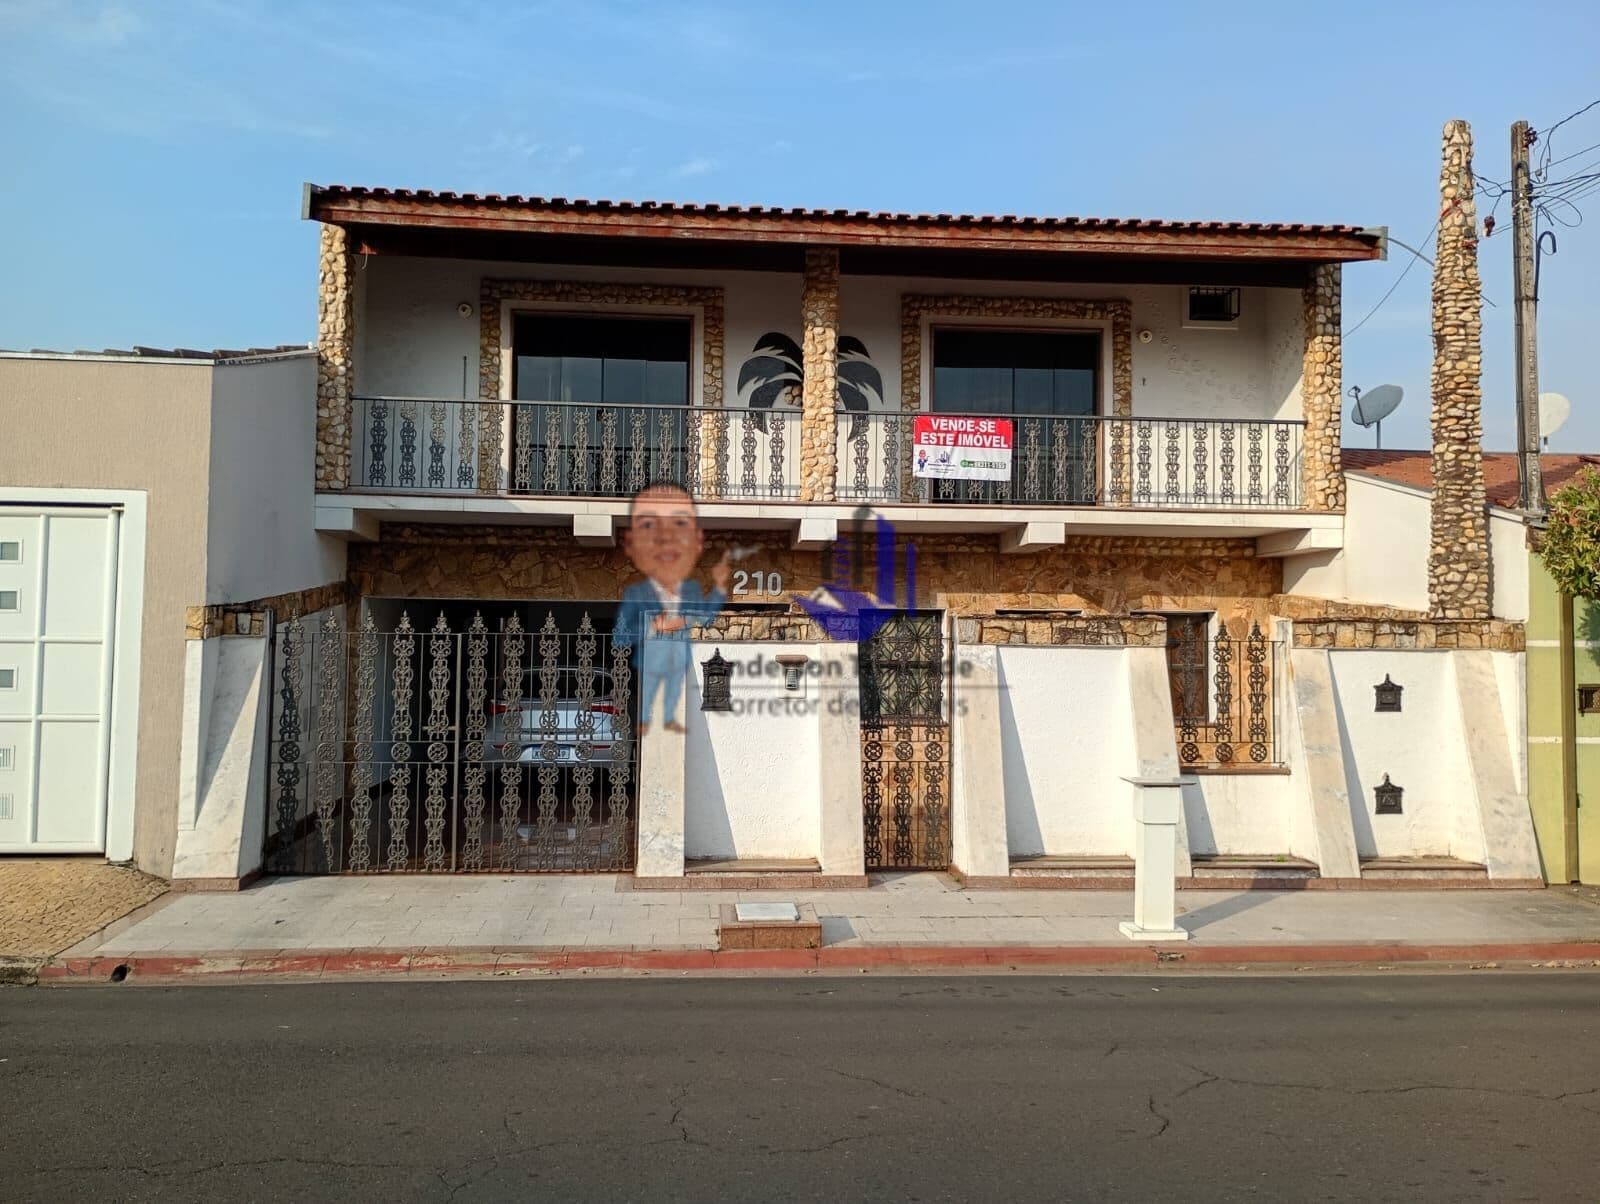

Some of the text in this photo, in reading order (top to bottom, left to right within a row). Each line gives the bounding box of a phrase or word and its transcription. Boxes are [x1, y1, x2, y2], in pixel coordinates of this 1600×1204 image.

[931, 418, 996, 433] VENDE-SE
[920, 431, 1009, 448] ESTE IMÓVEL
[733, 570, 782, 597] 210
